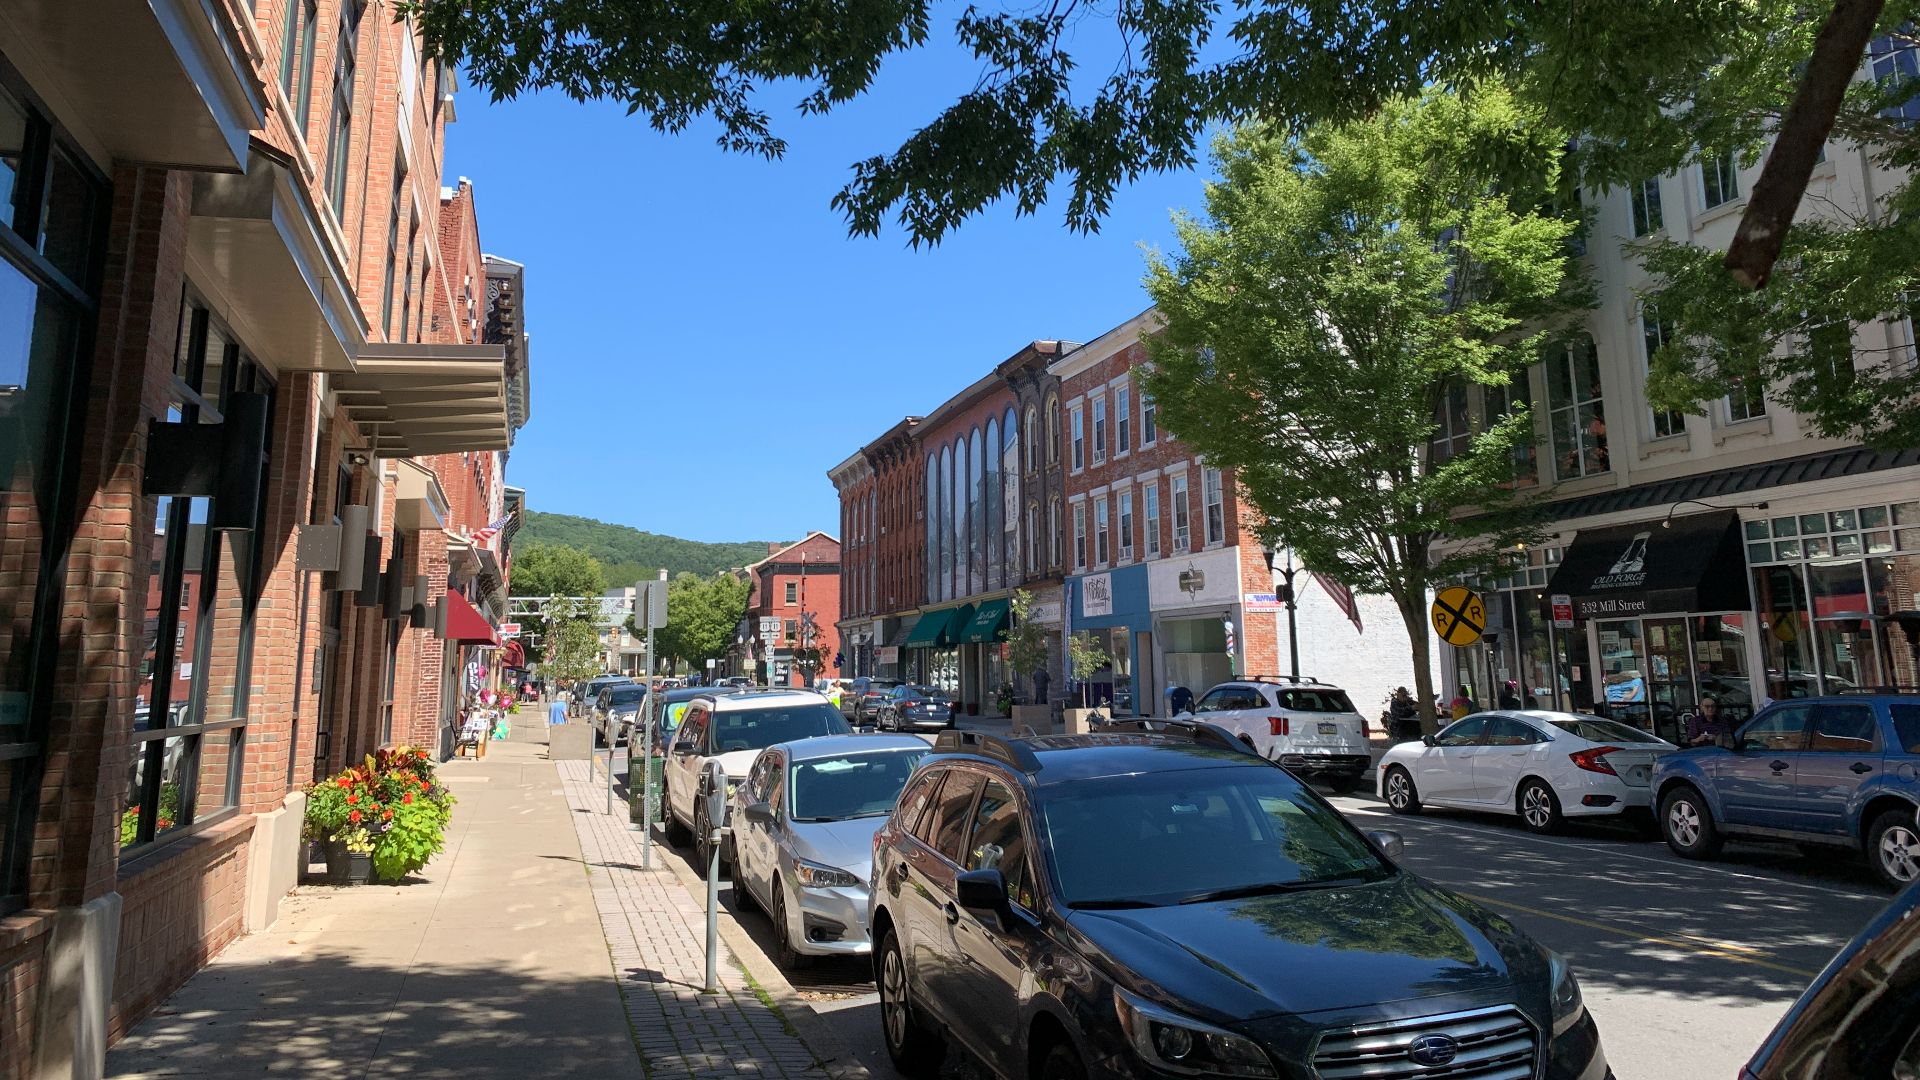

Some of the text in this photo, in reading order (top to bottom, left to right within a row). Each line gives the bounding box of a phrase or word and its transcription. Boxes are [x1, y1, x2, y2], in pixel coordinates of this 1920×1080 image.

[1594, 572, 1647, 584] OLD FORGE
[1581, 599, 1646, 613] 532 Mill Street
[1436, 605, 1482, 627] R R
